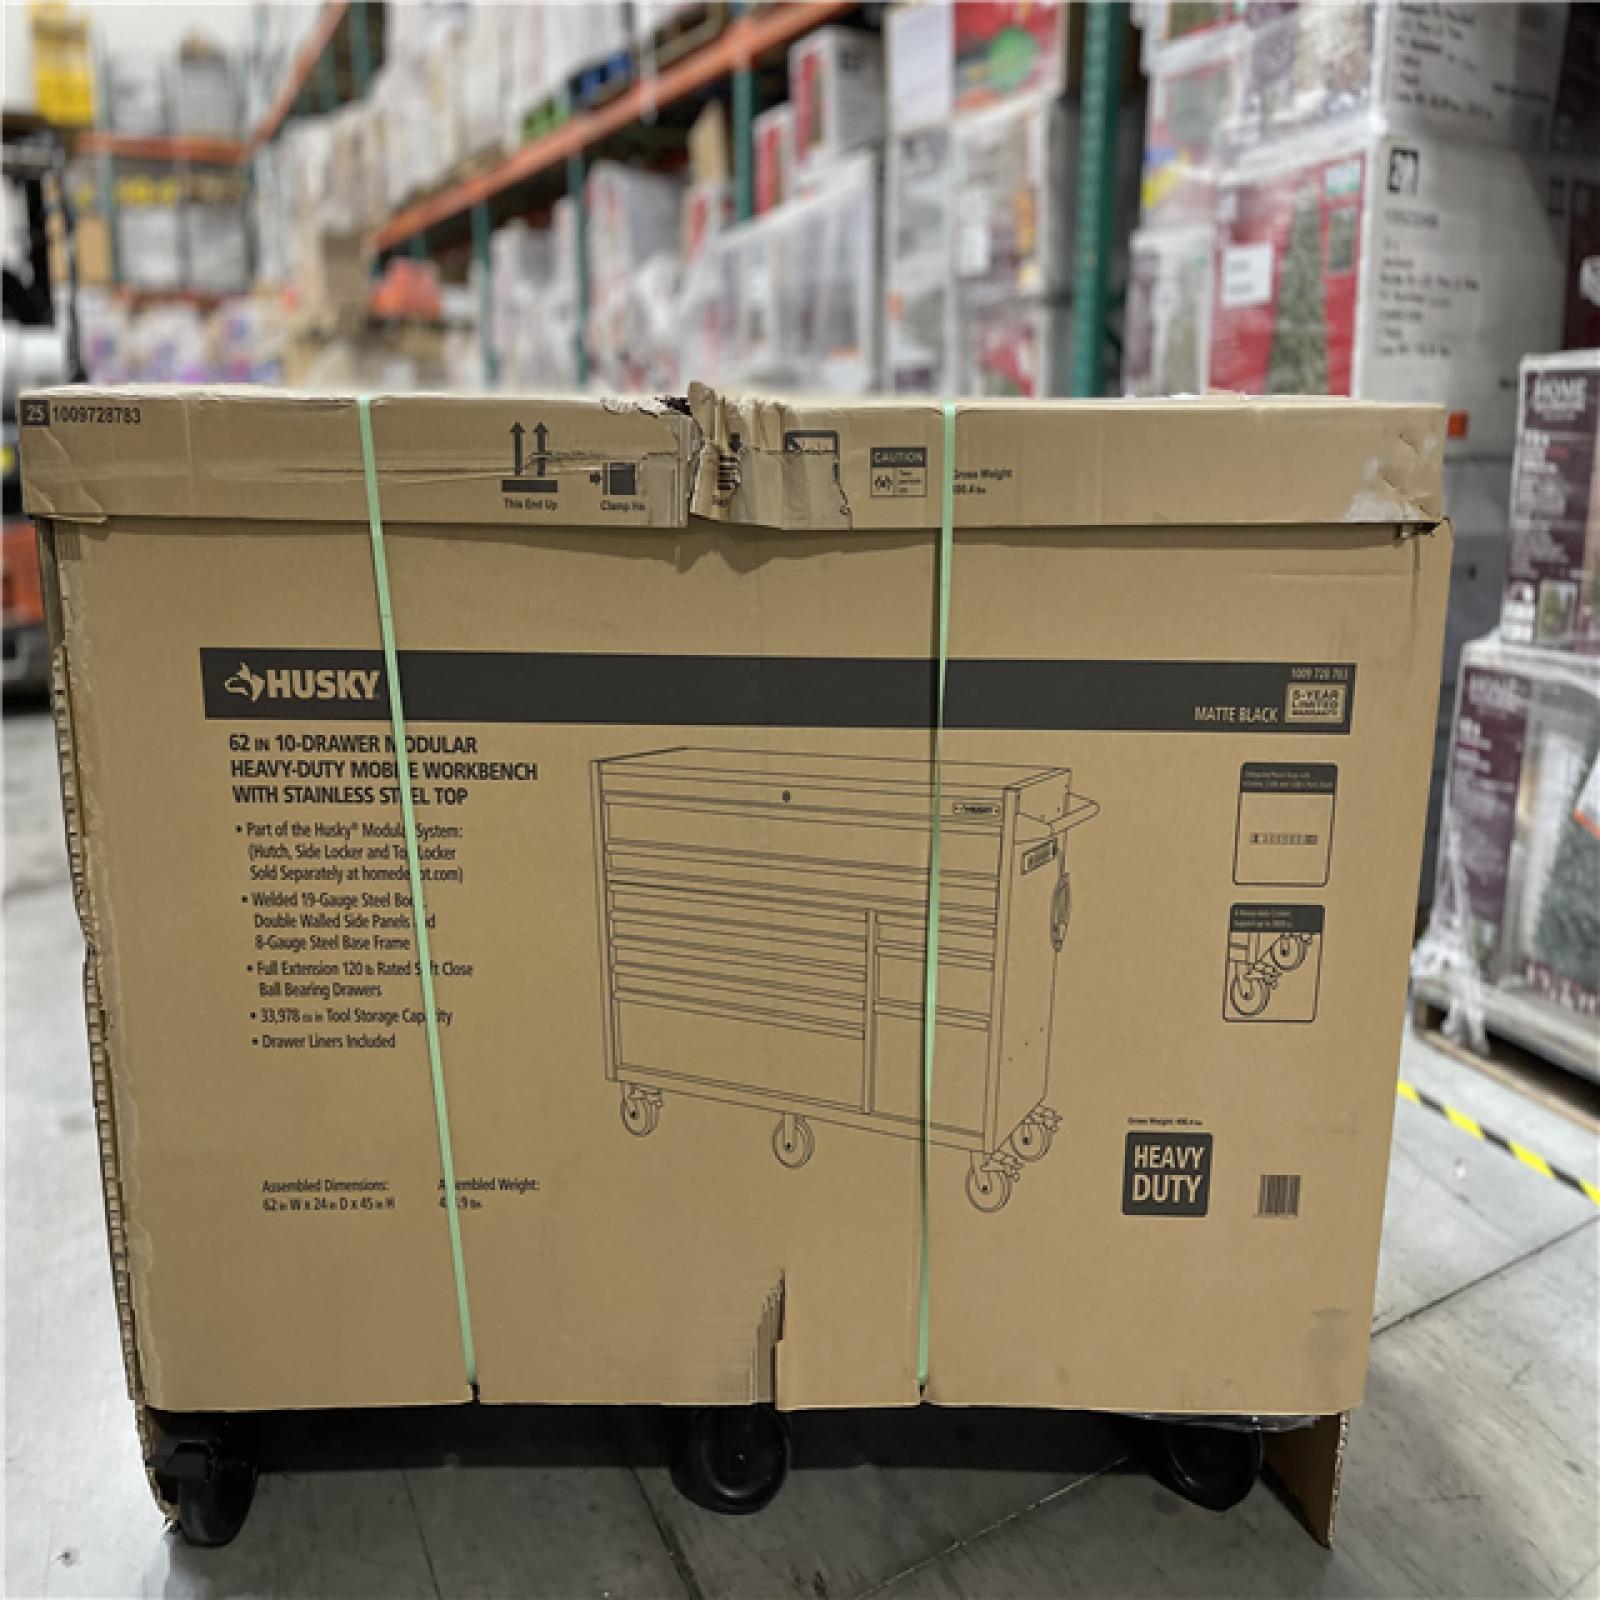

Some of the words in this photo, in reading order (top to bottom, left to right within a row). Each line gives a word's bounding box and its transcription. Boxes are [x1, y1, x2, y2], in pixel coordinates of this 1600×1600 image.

[266, 669, 381, 699] HUSKY
[1194, 705, 1236, 722] MATTE
[1240, 706, 1279, 723] BLACK
[229, 735, 249, 750] 62
[275, 735, 380, 753] 10-DRAWER
[231, 760, 345, 778] HEAVY-DUTY
[351, 761, 418, 778] MOBIE
[423, 762, 538, 780] WORKBENCH
[232, 785, 278, 803] WITH
[283, 786, 375, 804] STAINLESS
[380, 787, 430, 805] STEL
[434, 787, 468, 805] TOP
[247, 822, 272, 838] Part
[275, 821, 289, 838] of
[292, 822, 311, 838] the
[294, 844, 321, 860] Side
[324, 844, 363, 860] Locker
[367, 845, 390, 860] and
[418, 845, 456, 860] Locker
[250, 865, 277, 880] Sold
[280, 865, 343, 884] Separately
[347, 867, 360, 880] at
[252, 892, 298, 908] Welded
[302, 892, 358, 910] 19-Gauge
[361, 892, 390, 908] Steel
[254, 913, 297, 928] Double
[300, 913, 341, 928] Walled
[344, 913, 370, 928] Side
[372, 914, 411, 928] Panels
[255, 934, 306, 952] 8-Gauge
[309, 934, 340, 950] Steel
[342, 935, 370, 950] Base
[373, 935, 411, 950] Frame
[256, 961, 279, 976] Full
[281, 960, 340, 976] Extension
[342, 961, 364, 976] 120
[377, 960, 411, 976] Rated
[442, 961, 474, 976] Close
[258, 982, 281, 996] Ball
[284, 981, 331, 1000] Bearing
[332, 982, 382, 996] Drawers
[261, 1008, 300, 1025] 33,978
[326, 1008, 351, 1023] Tool
[354, 1008, 400, 1027] Storage
[262, 1034, 305, 1048] Drawer
[309, 1033, 343, 1048] Liners
[347, 1033, 396, 1049] Included
[1134, 1145, 1205, 1170] HEAVY
[262, 1178, 321, 1193] Assembled
[324, 1178, 390, 1192] Dimensions:
[1132, 1174, 1203, 1204] DUTY
[315, 1197, 327, 1210] 24
[340, 1197, 349, 1210] D
[360, 1197, 373, 1210] 45
